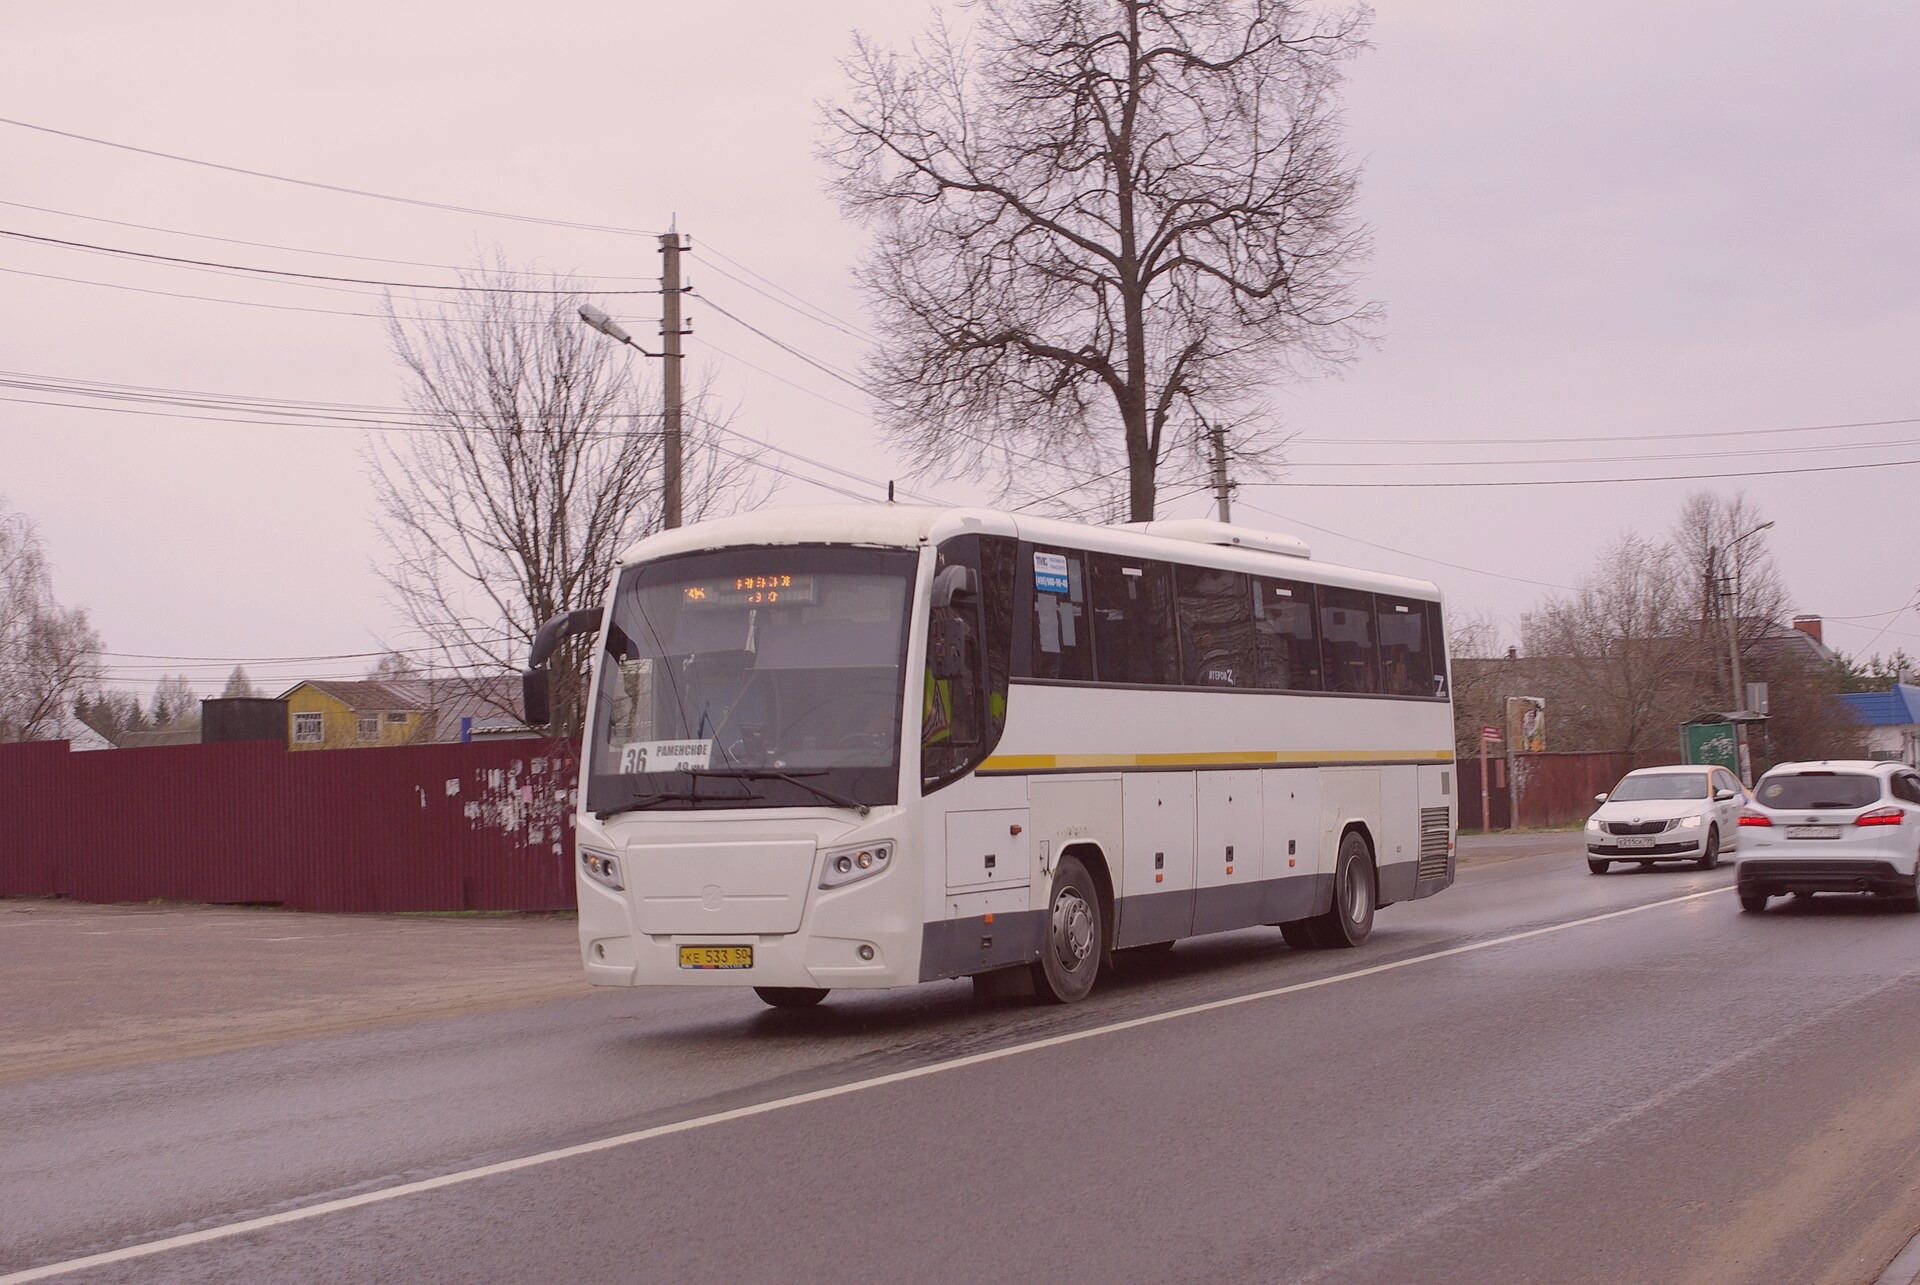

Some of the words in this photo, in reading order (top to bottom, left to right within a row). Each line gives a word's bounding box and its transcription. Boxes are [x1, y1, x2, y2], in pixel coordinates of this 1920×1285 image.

[625, 748, 648, 773] 36
[656, 744, 708, 757] РАМЕНСКОЕ
[685, 952, 700, 963] КЕ
[705, 949, 728, 963] 533
[735, 948, 748, 959] 50
